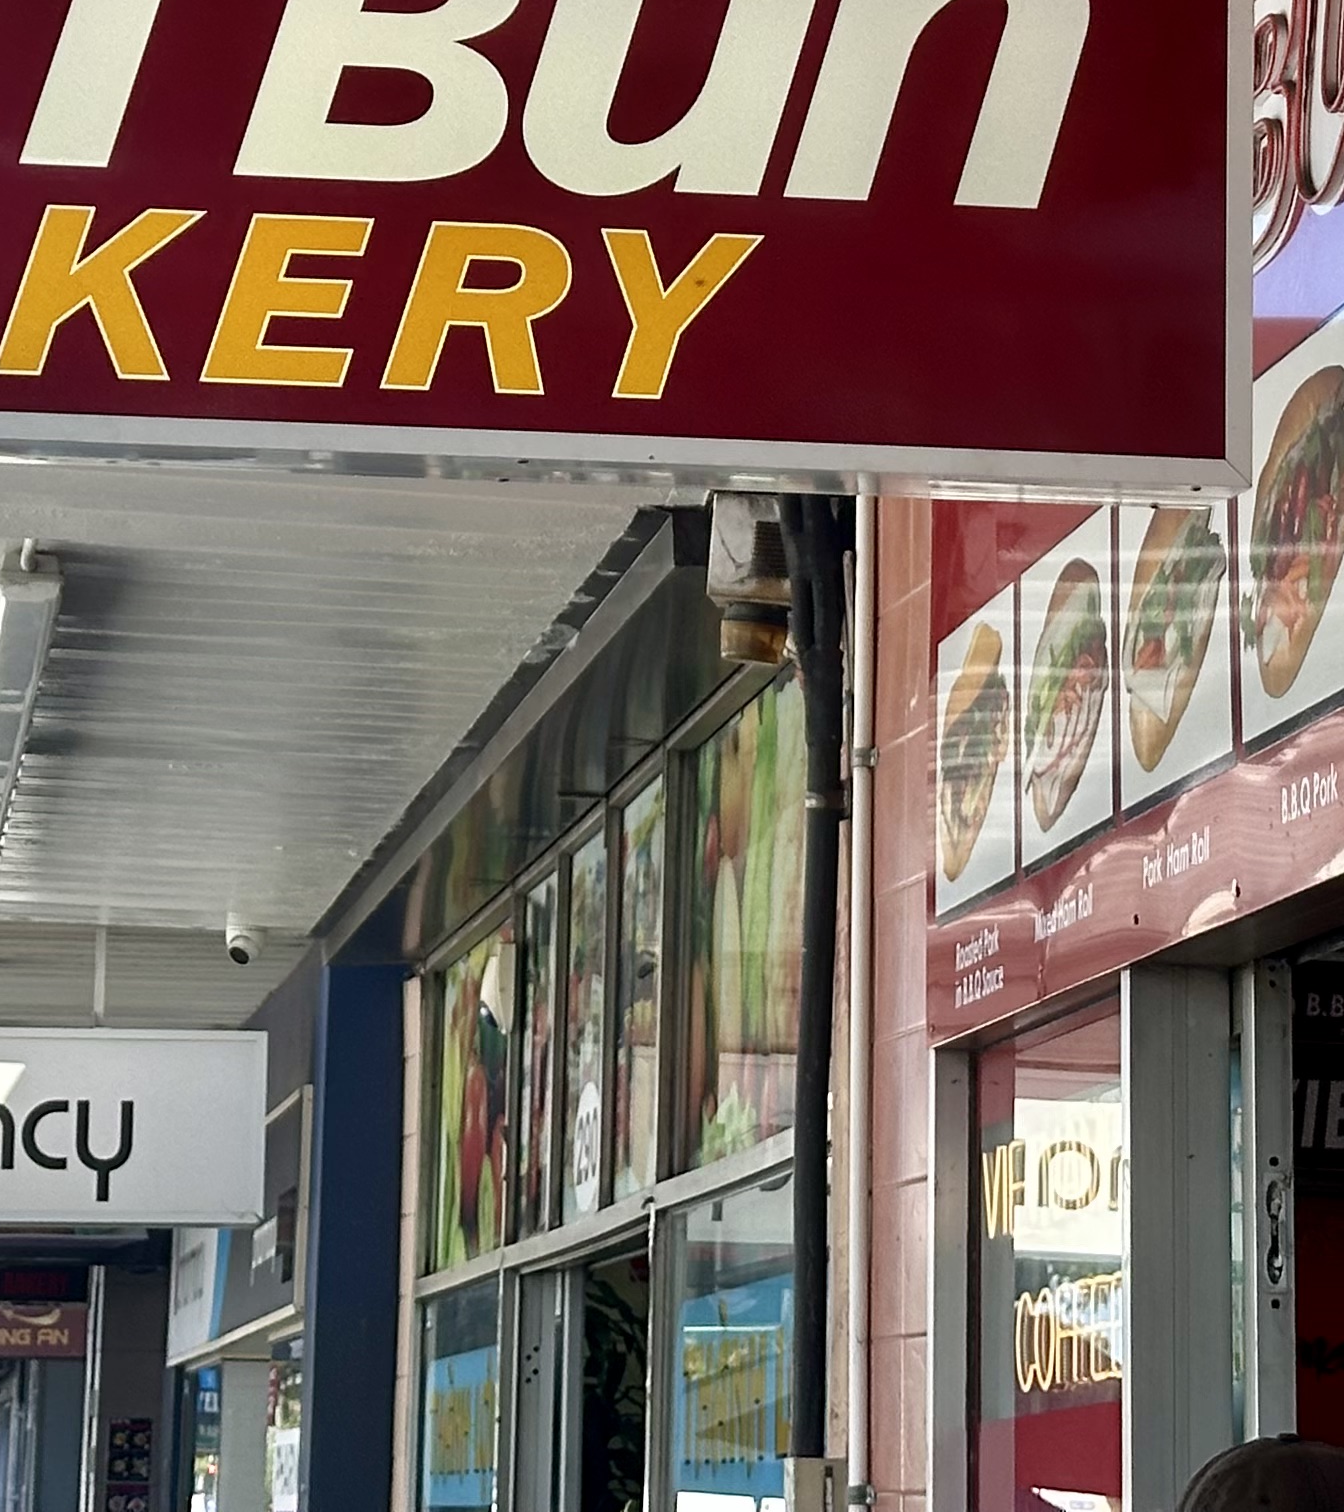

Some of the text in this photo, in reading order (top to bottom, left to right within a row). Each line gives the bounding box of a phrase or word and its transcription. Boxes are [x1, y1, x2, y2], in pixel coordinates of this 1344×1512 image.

[1281, 763, 1340, 824] B.B.Q Pork
[1166, 843, 1189, 878] Ham
[1191, 826, 1210, 866] Roll
